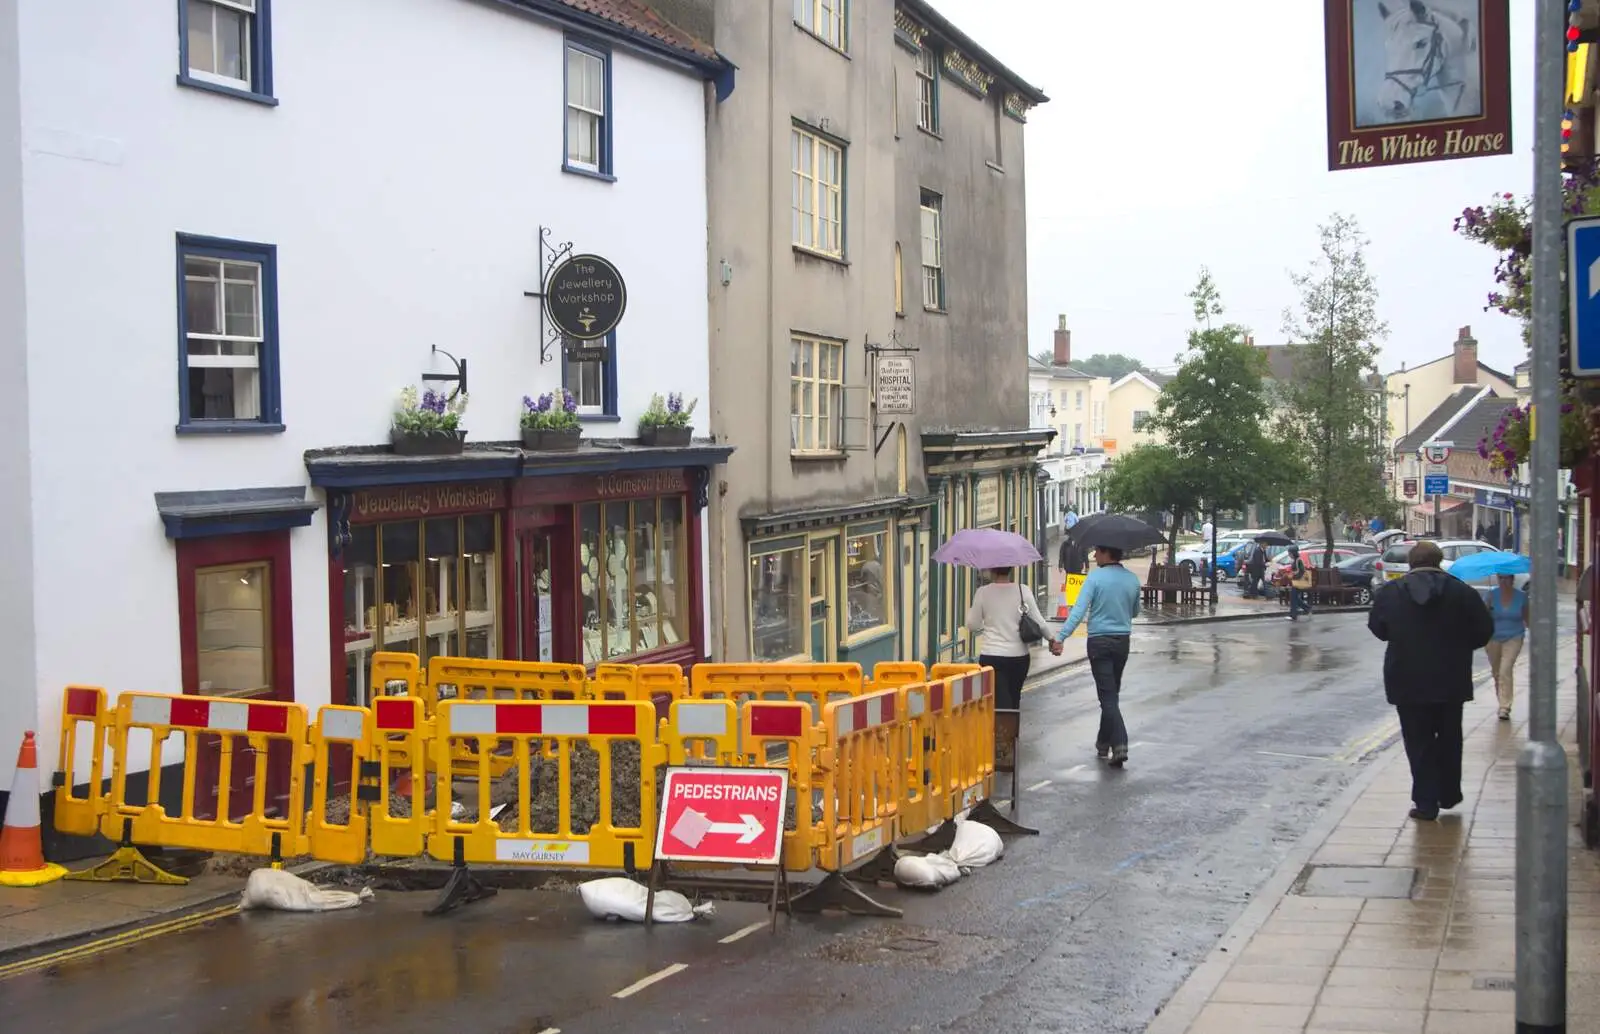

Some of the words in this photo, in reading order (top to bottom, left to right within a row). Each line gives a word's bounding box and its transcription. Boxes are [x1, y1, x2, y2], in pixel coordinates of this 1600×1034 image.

[1338, 139, 1374, 165] The
[1381, 133, 1437, 161] White
[1443, 129, 1504, 155] Horse
[575, 263, 595, 274] The
[559, 279, 612, 290] Jewellery
[559, 292, 614, 303] Workshop
[880, 376, 911, 384] HOSPITAL
[358, 487, 430, 516] Jewellery
[674, 783, 778, 801] PEDESTRIANS
